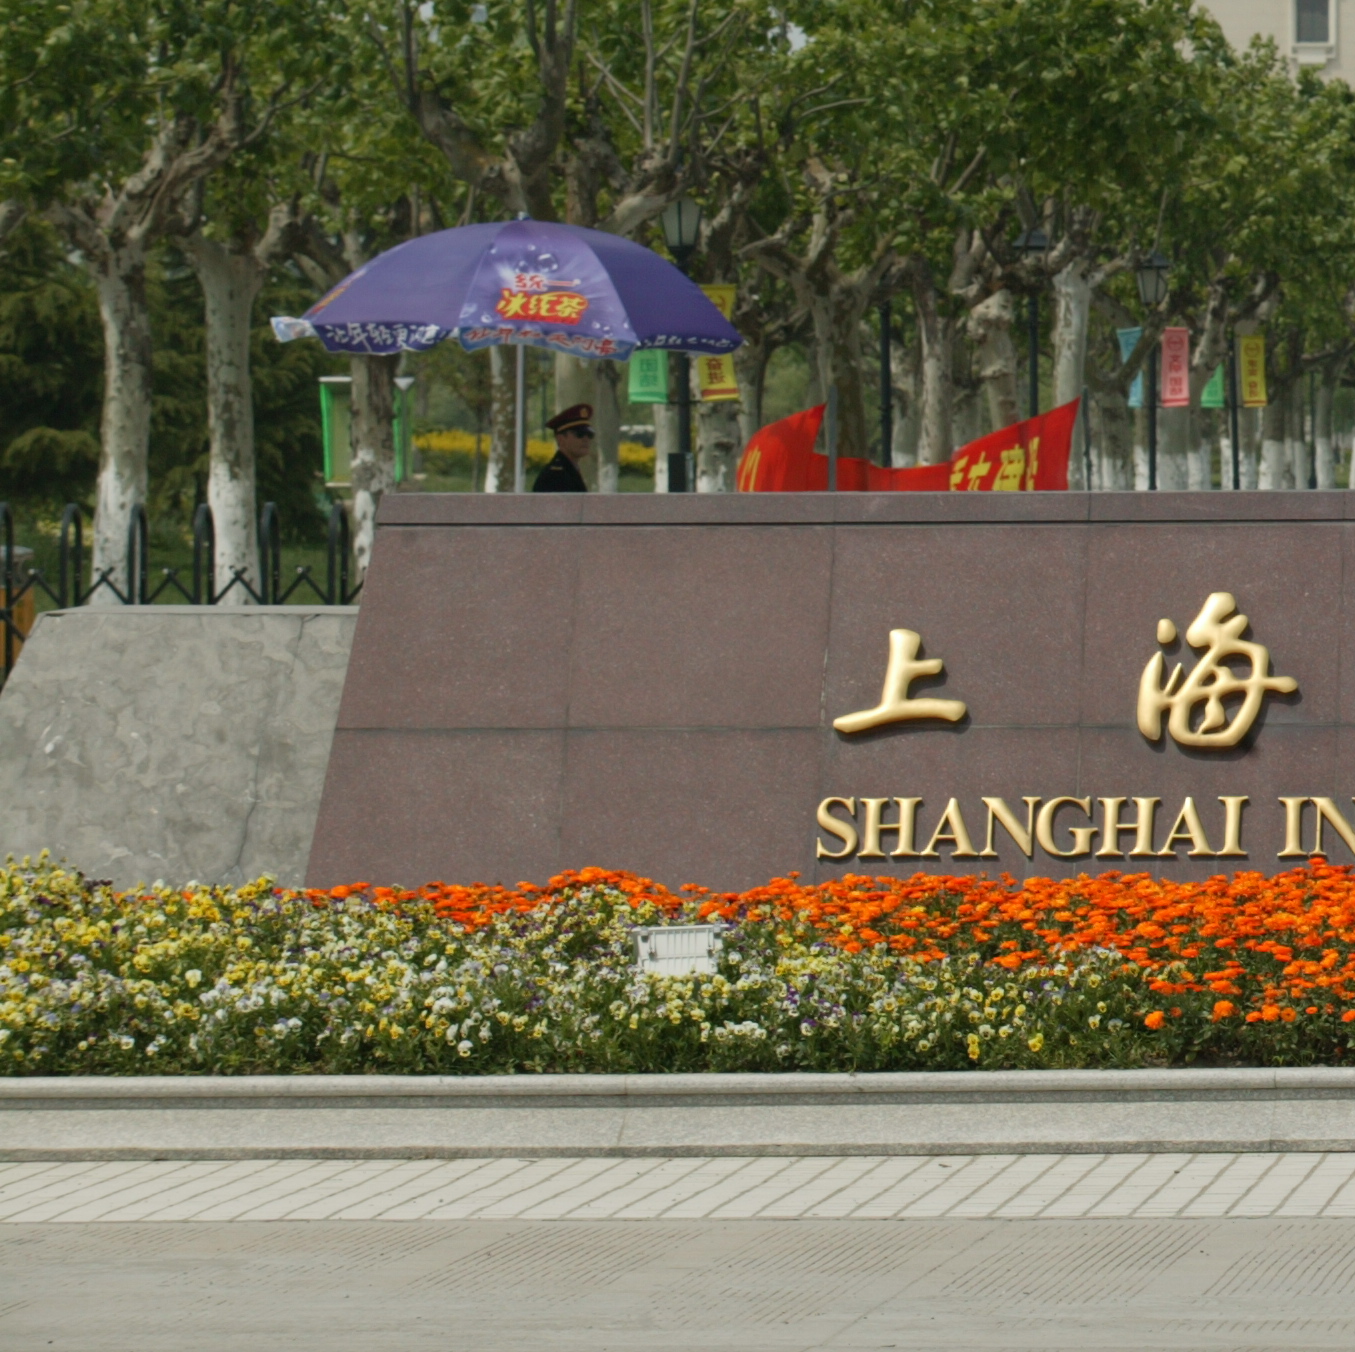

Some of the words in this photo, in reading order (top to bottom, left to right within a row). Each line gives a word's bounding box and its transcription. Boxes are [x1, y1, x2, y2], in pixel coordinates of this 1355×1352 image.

[497, 289, 586, 319] 冰红茶
[815, 794, 1249, 860] SHANGHAI
